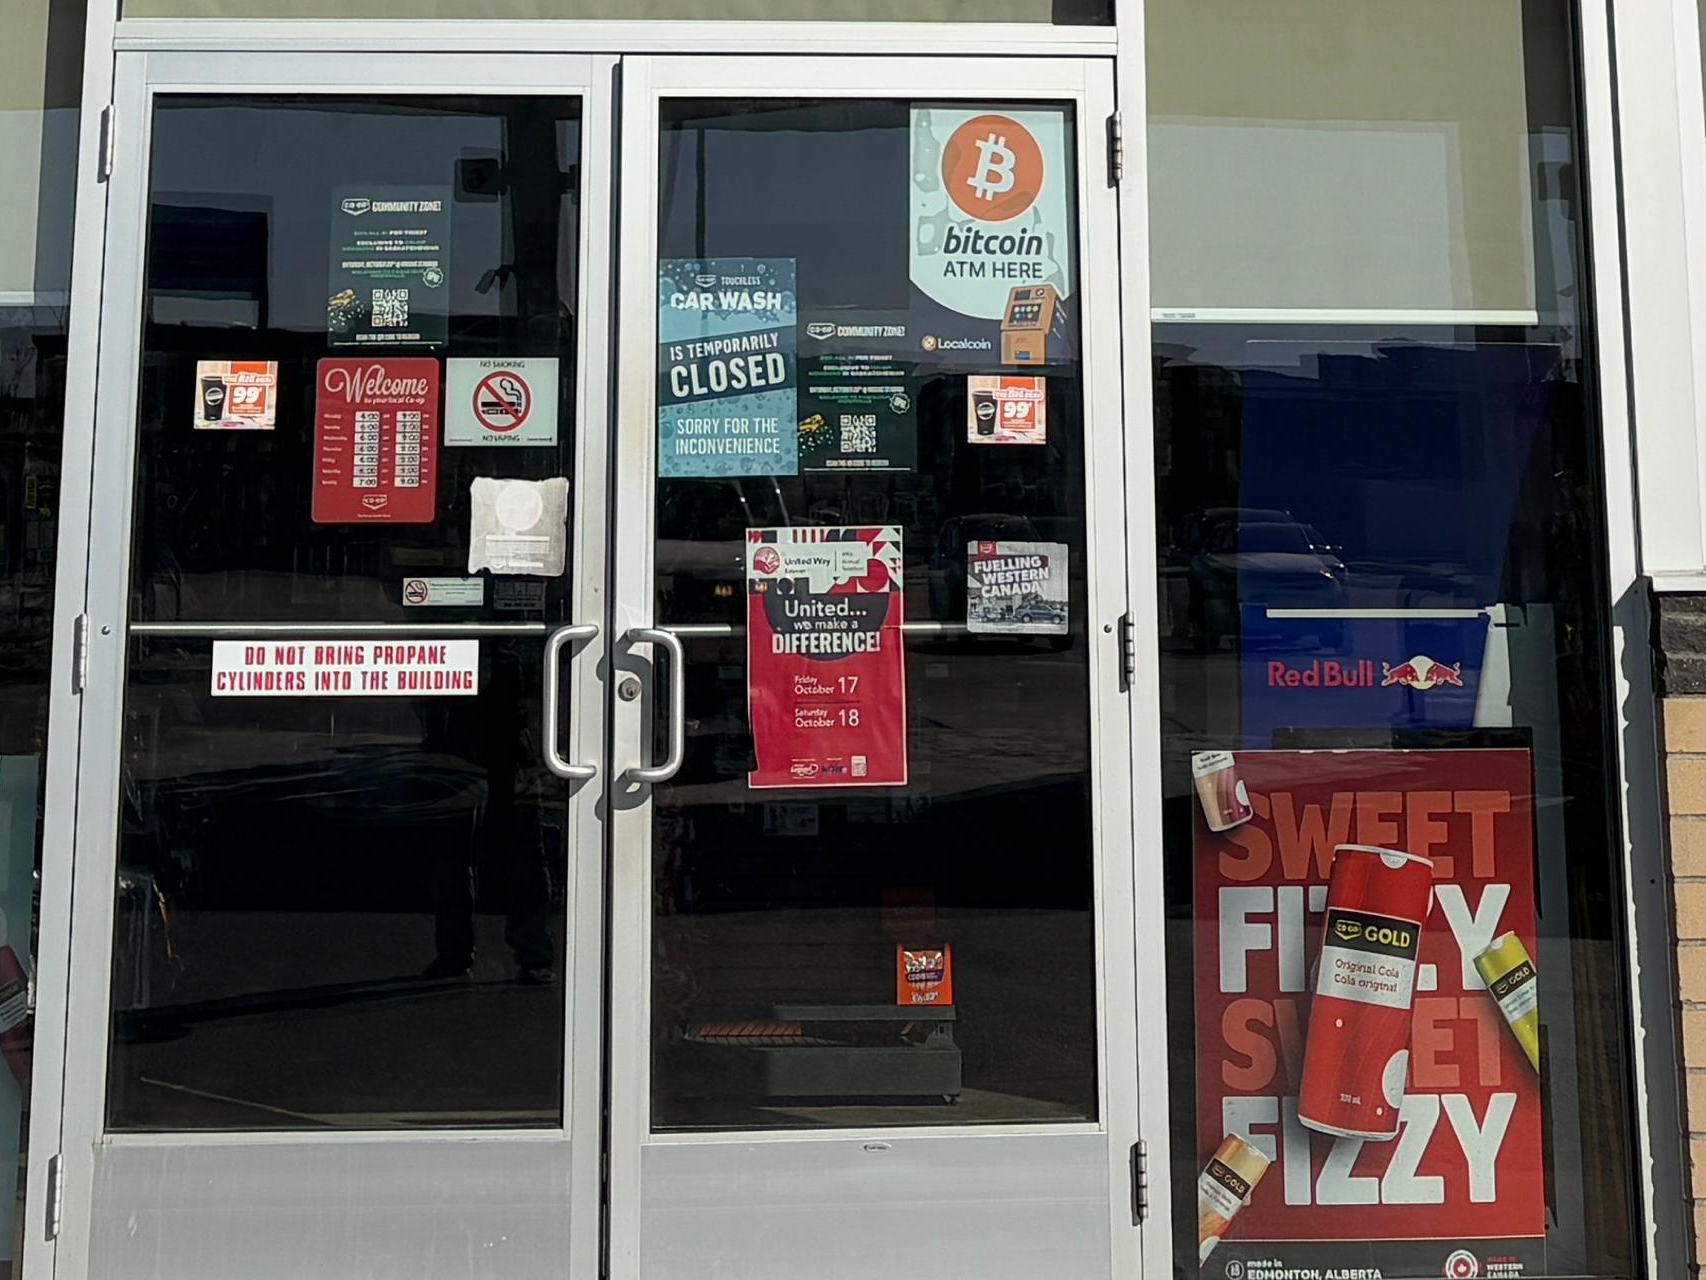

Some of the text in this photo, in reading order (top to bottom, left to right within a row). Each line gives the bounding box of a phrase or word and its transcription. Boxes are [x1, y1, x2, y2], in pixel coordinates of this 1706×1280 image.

[372, 200, 417, 212] COMMUNITY
[943, 226, 1043, 256] bitcoin
[943, 261, 1043, 279] ATM HERE
[721, 276, 761, 286] TOUCHLESS
[670, 291, 782, 311] CAR WASH
[809, 326, 833, 334] CO-OP
[837, 326, 882, 337] COMMUNITY
[670, 332, 779, 361] IS TEMPORARILY
[938, 338, 991, 350] Localcoin
[480, 360, 525, 368] NO SMOKING
[324, 364, 429, 403] Welcome
[670, 352, 786, 398] CLOSED
[364, 396, 372, 404] to
[373, 397, 388, 406] your
[405, 396, 425, 405] Co-op
[677, 417, 779, 435] SORRY FOR THE
[675, 437, 781, 455] INCONVENIENCE
[363, 497, 387, 505] CO-OP
[784, 557, 812, 566] United
[813, 557, 831, 567] Way
[974, 556, 1042, 574] FUELLING
[982, 567, 1049, 584] WESTERN
[981, 581, 1041, 598] CANADA
[784, 598, 867, 618] United...
[794, 617, 858, 630] we make a
[772, 631, 881, 654] DIFFERENCE!
[245, 646, 447, 665] DO NOT BRING PROPANE
[216, 671, 473, 691] CYLINDERS INTO THE BUILDING
[794, 675, 818, 685] Friday
[1268, 660, 1374, 687] Red Bull
[794, 676, 858, 695] October 17
[795, 708, 828, 719] Saturday
[795, 709, 859, 728] October 18
[1219, 791, 1511, 881] SWEET
[1218, 884, 1511, 993] FIY
[1337, 923, 1410, 947] CO-OP GOLD
[1335, 959, 1399, 979] Original Cola
[1508, 966, 1530, 985] GOLD
[1334, 973, 1397, 993] Cola original
[1221, 997, 1501, 1091] SET
[1224, 1174, 1245, 1194] GOLD
[1247, 1259, 1283, 1268] made in
[1487, 1263, 1524, 1271] WESTERN
[1247, 1269, 1383, 1280] EDMONTON, ALBERTA
